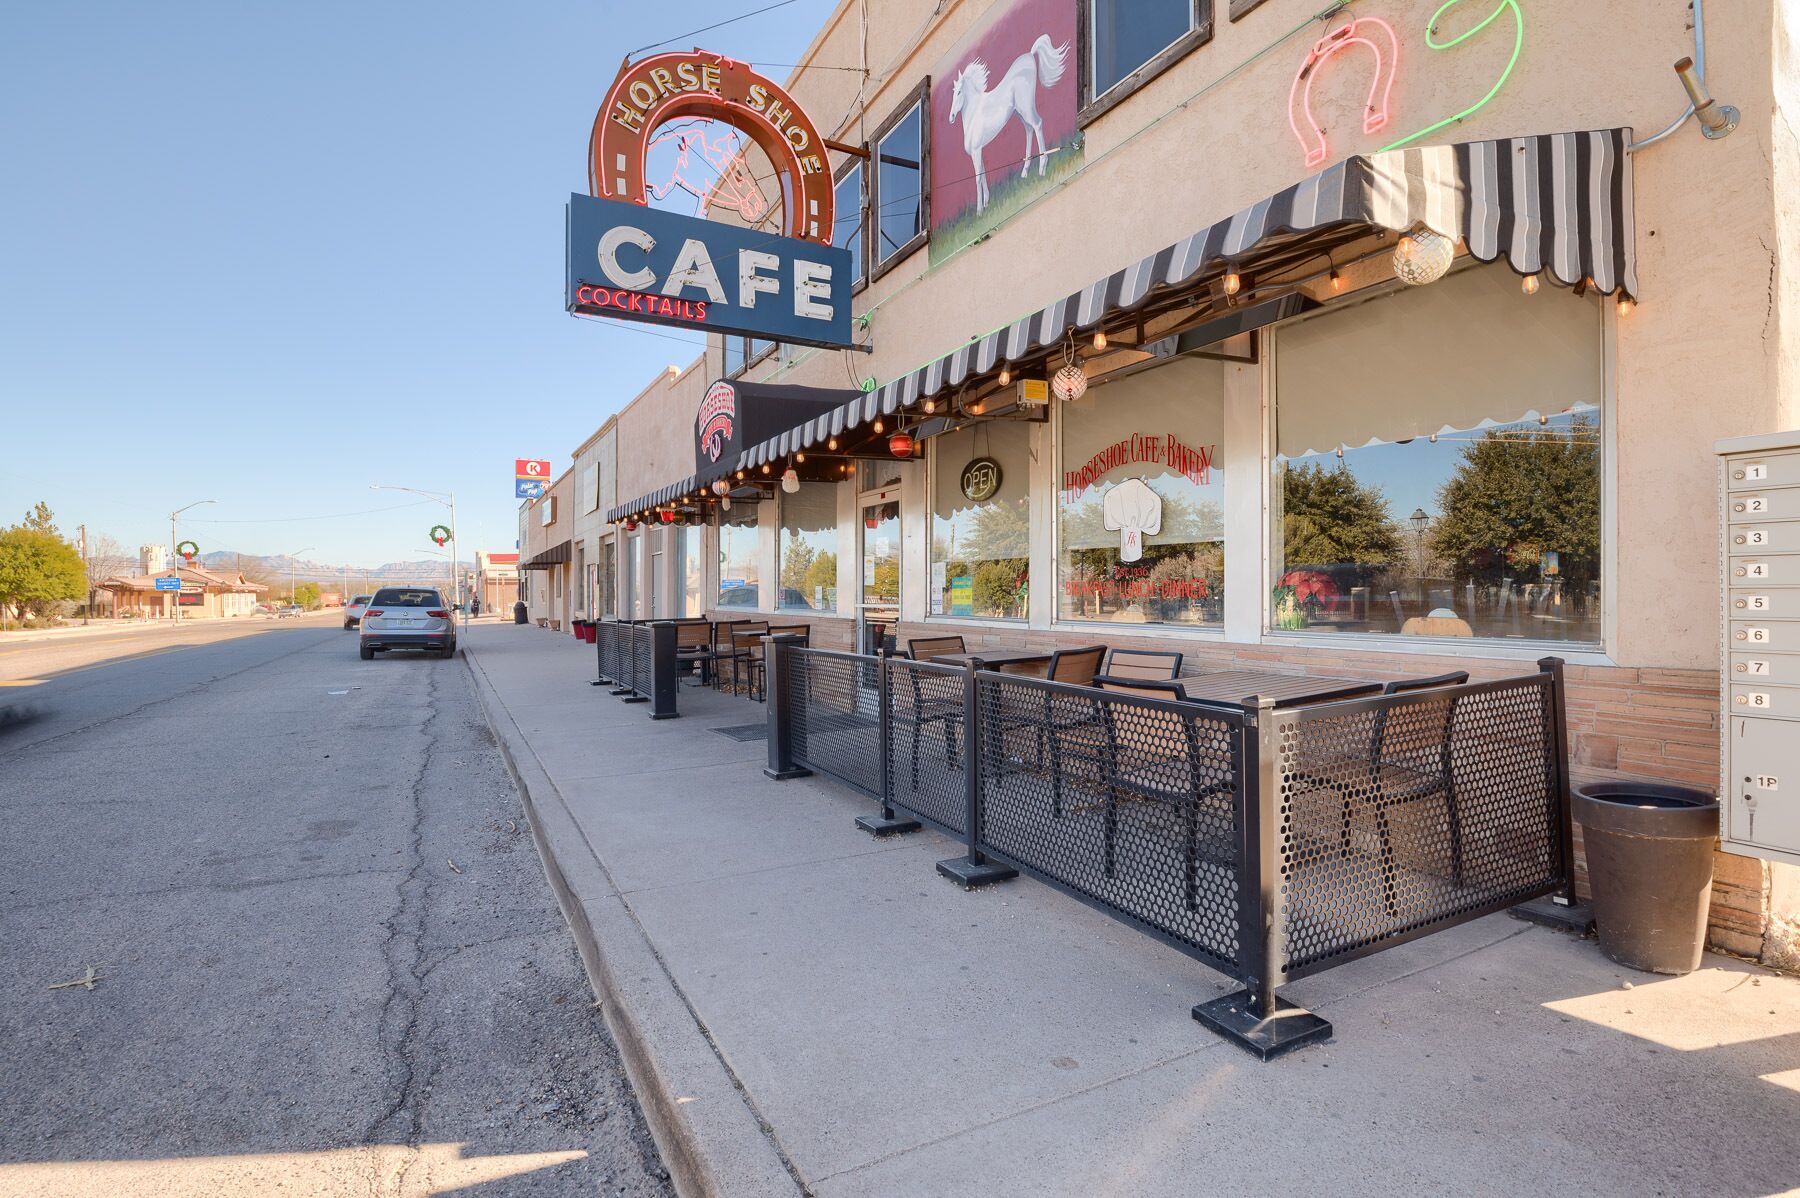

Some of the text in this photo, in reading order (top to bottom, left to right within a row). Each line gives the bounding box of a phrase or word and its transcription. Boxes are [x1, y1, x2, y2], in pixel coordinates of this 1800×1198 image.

[612, 62, 822, 175] HORSE SHOE
[597, 225, 834, 321] CAFE
[576, 286, 706, 321] COCKTAILS
[1066, 432, 1216, 504] HORSESHOE CAFE & BAKERY
[1753, 468, 1760, 478] 1
[964, 467, 997, 492] OPEN
[1752, 501, 1761, 510] 2
[1753, 533, 1762, 542] 3
[1131, 567, 1149, 577] 1936
[1753, 566, 1762, 575] 4
[1065, 578, 1208, 599] BREAKFAST LUNCH DINNER
[1754, 598, 1763, 607] 5
[1754, 631, 1763, 640] 6
[1754, 663, 1763, 673] 7
[1755, 696, 1763, 705] 8
[1758, 777, 1777, 787] 1P
